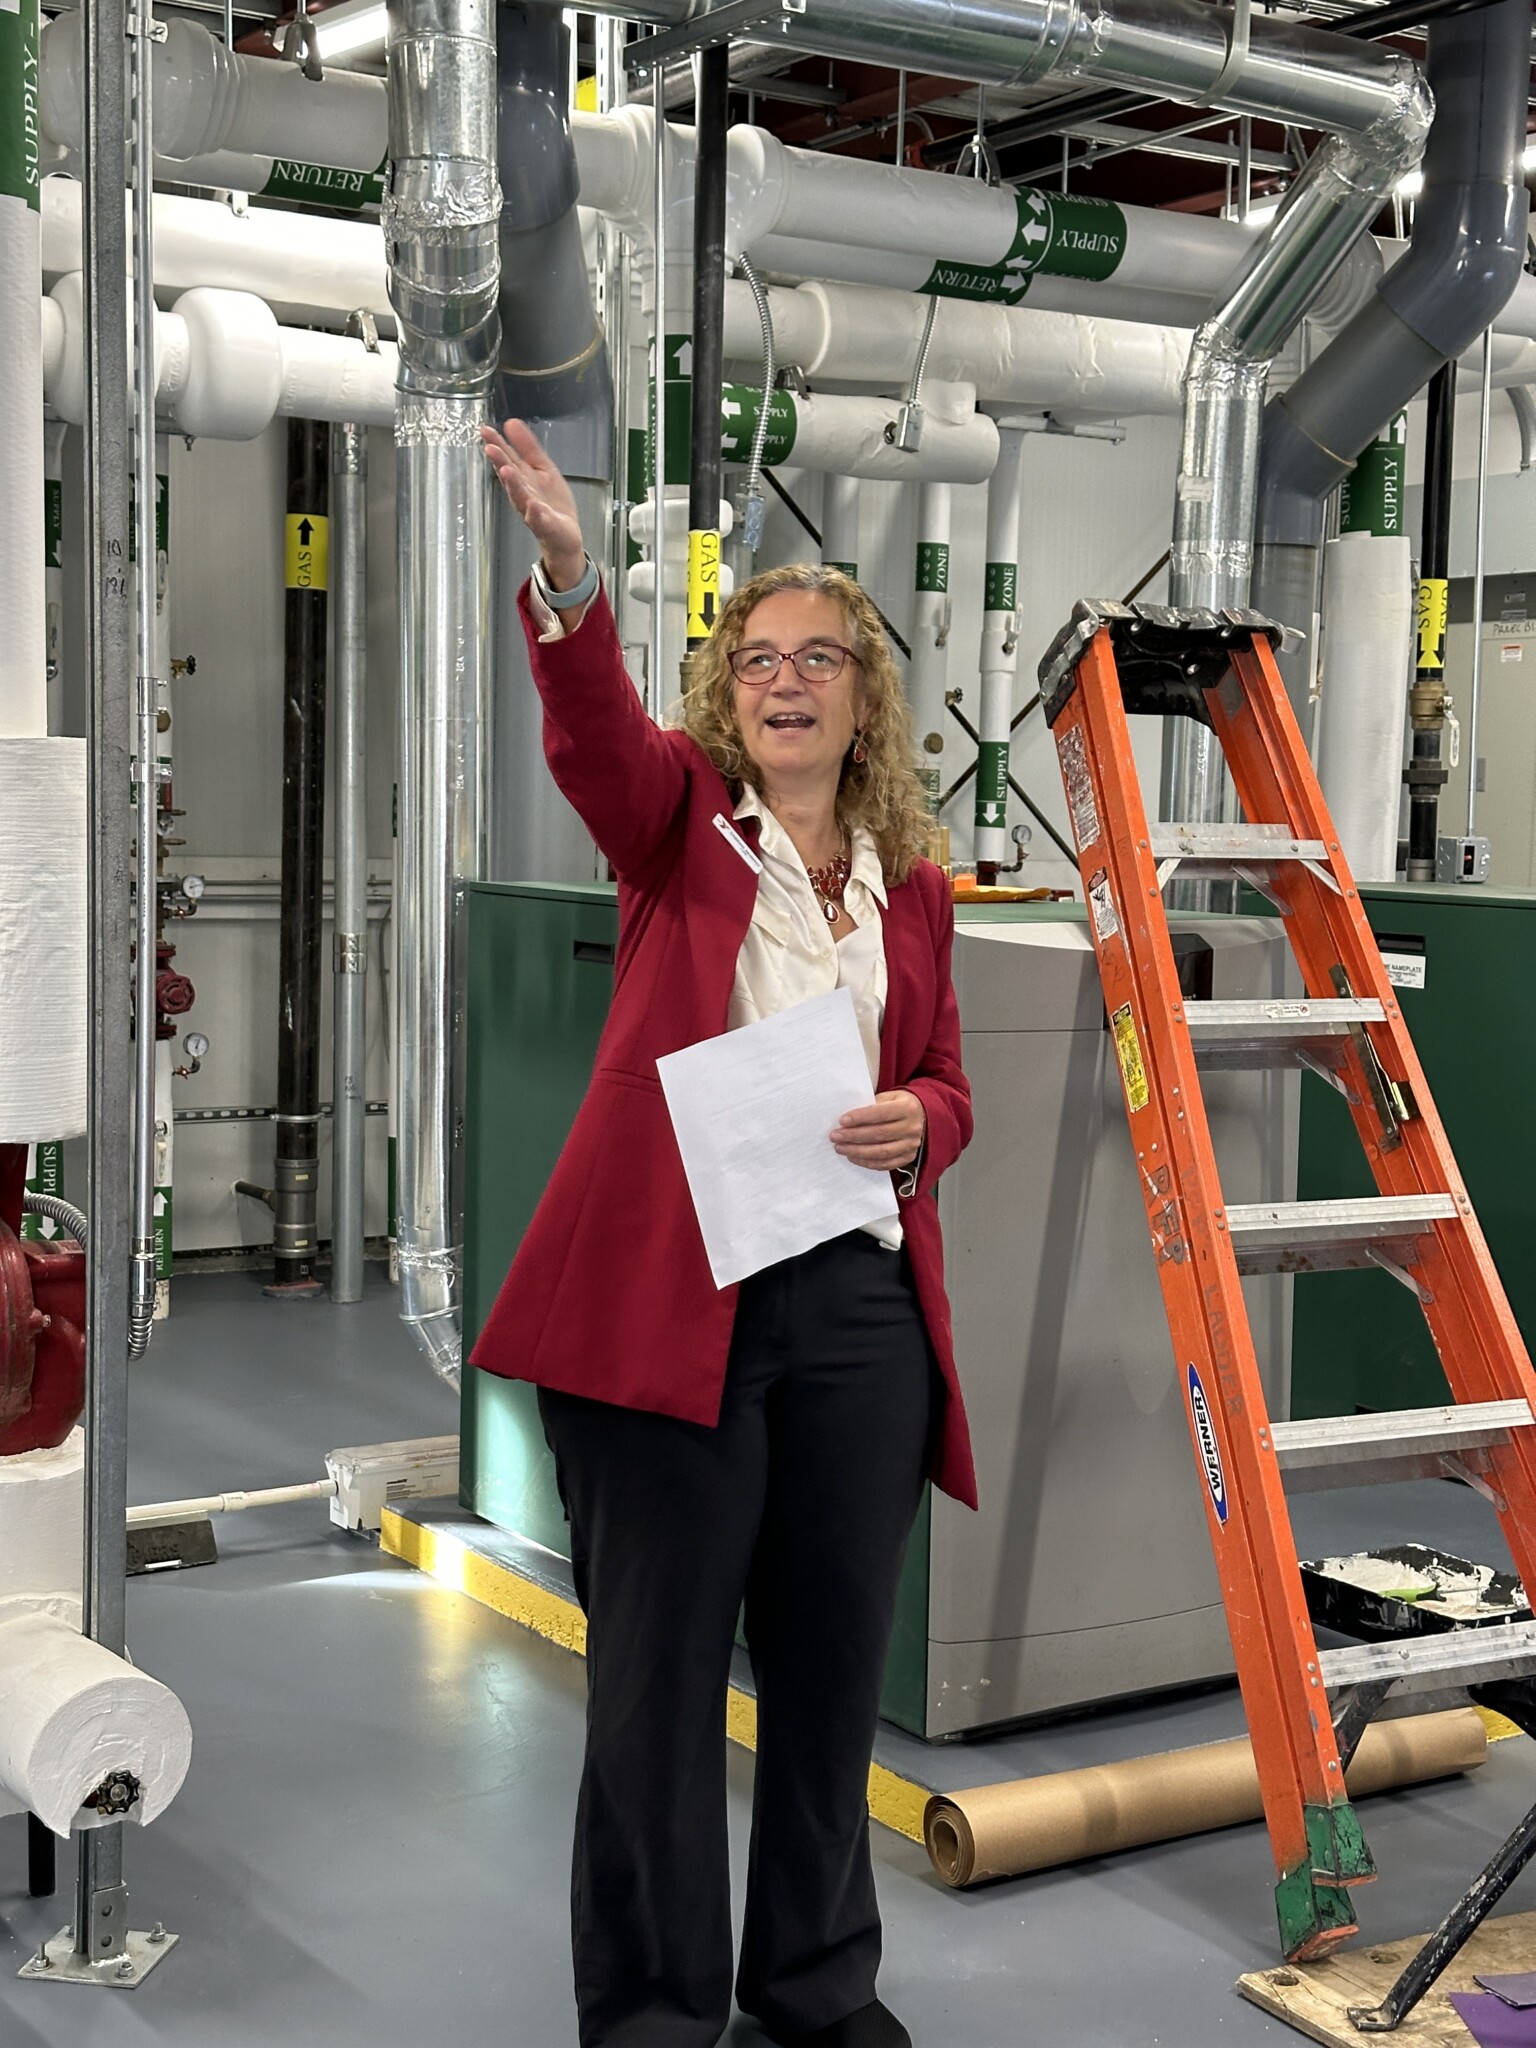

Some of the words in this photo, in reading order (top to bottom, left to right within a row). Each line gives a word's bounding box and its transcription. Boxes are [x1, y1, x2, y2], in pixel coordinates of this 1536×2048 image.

[23, 42, 39, 187] SUPPLY
[274, 161, 365, 192] RETURN
[1056, 229, 1119, 254] SUPPLY
[932, 268, 1000, 293] RETURN
[753, 405, 789, 418] SPPLY
[1384, 457, 1398, 529] SUPPLY
[297, 551, 312, 587] GAS
[700, 532, 718, 583] GAS
[936, 547, 948, 589] ZONE
[1002, 567, 1014, 608] ZONE
[1418, 585, 1432, 629] GAS
[996, 746, 1008, 799] SUPPLY
[43, 1146, 57, 1195] SUPPL
[1194, 1394, 1222, 1490] WERNER
